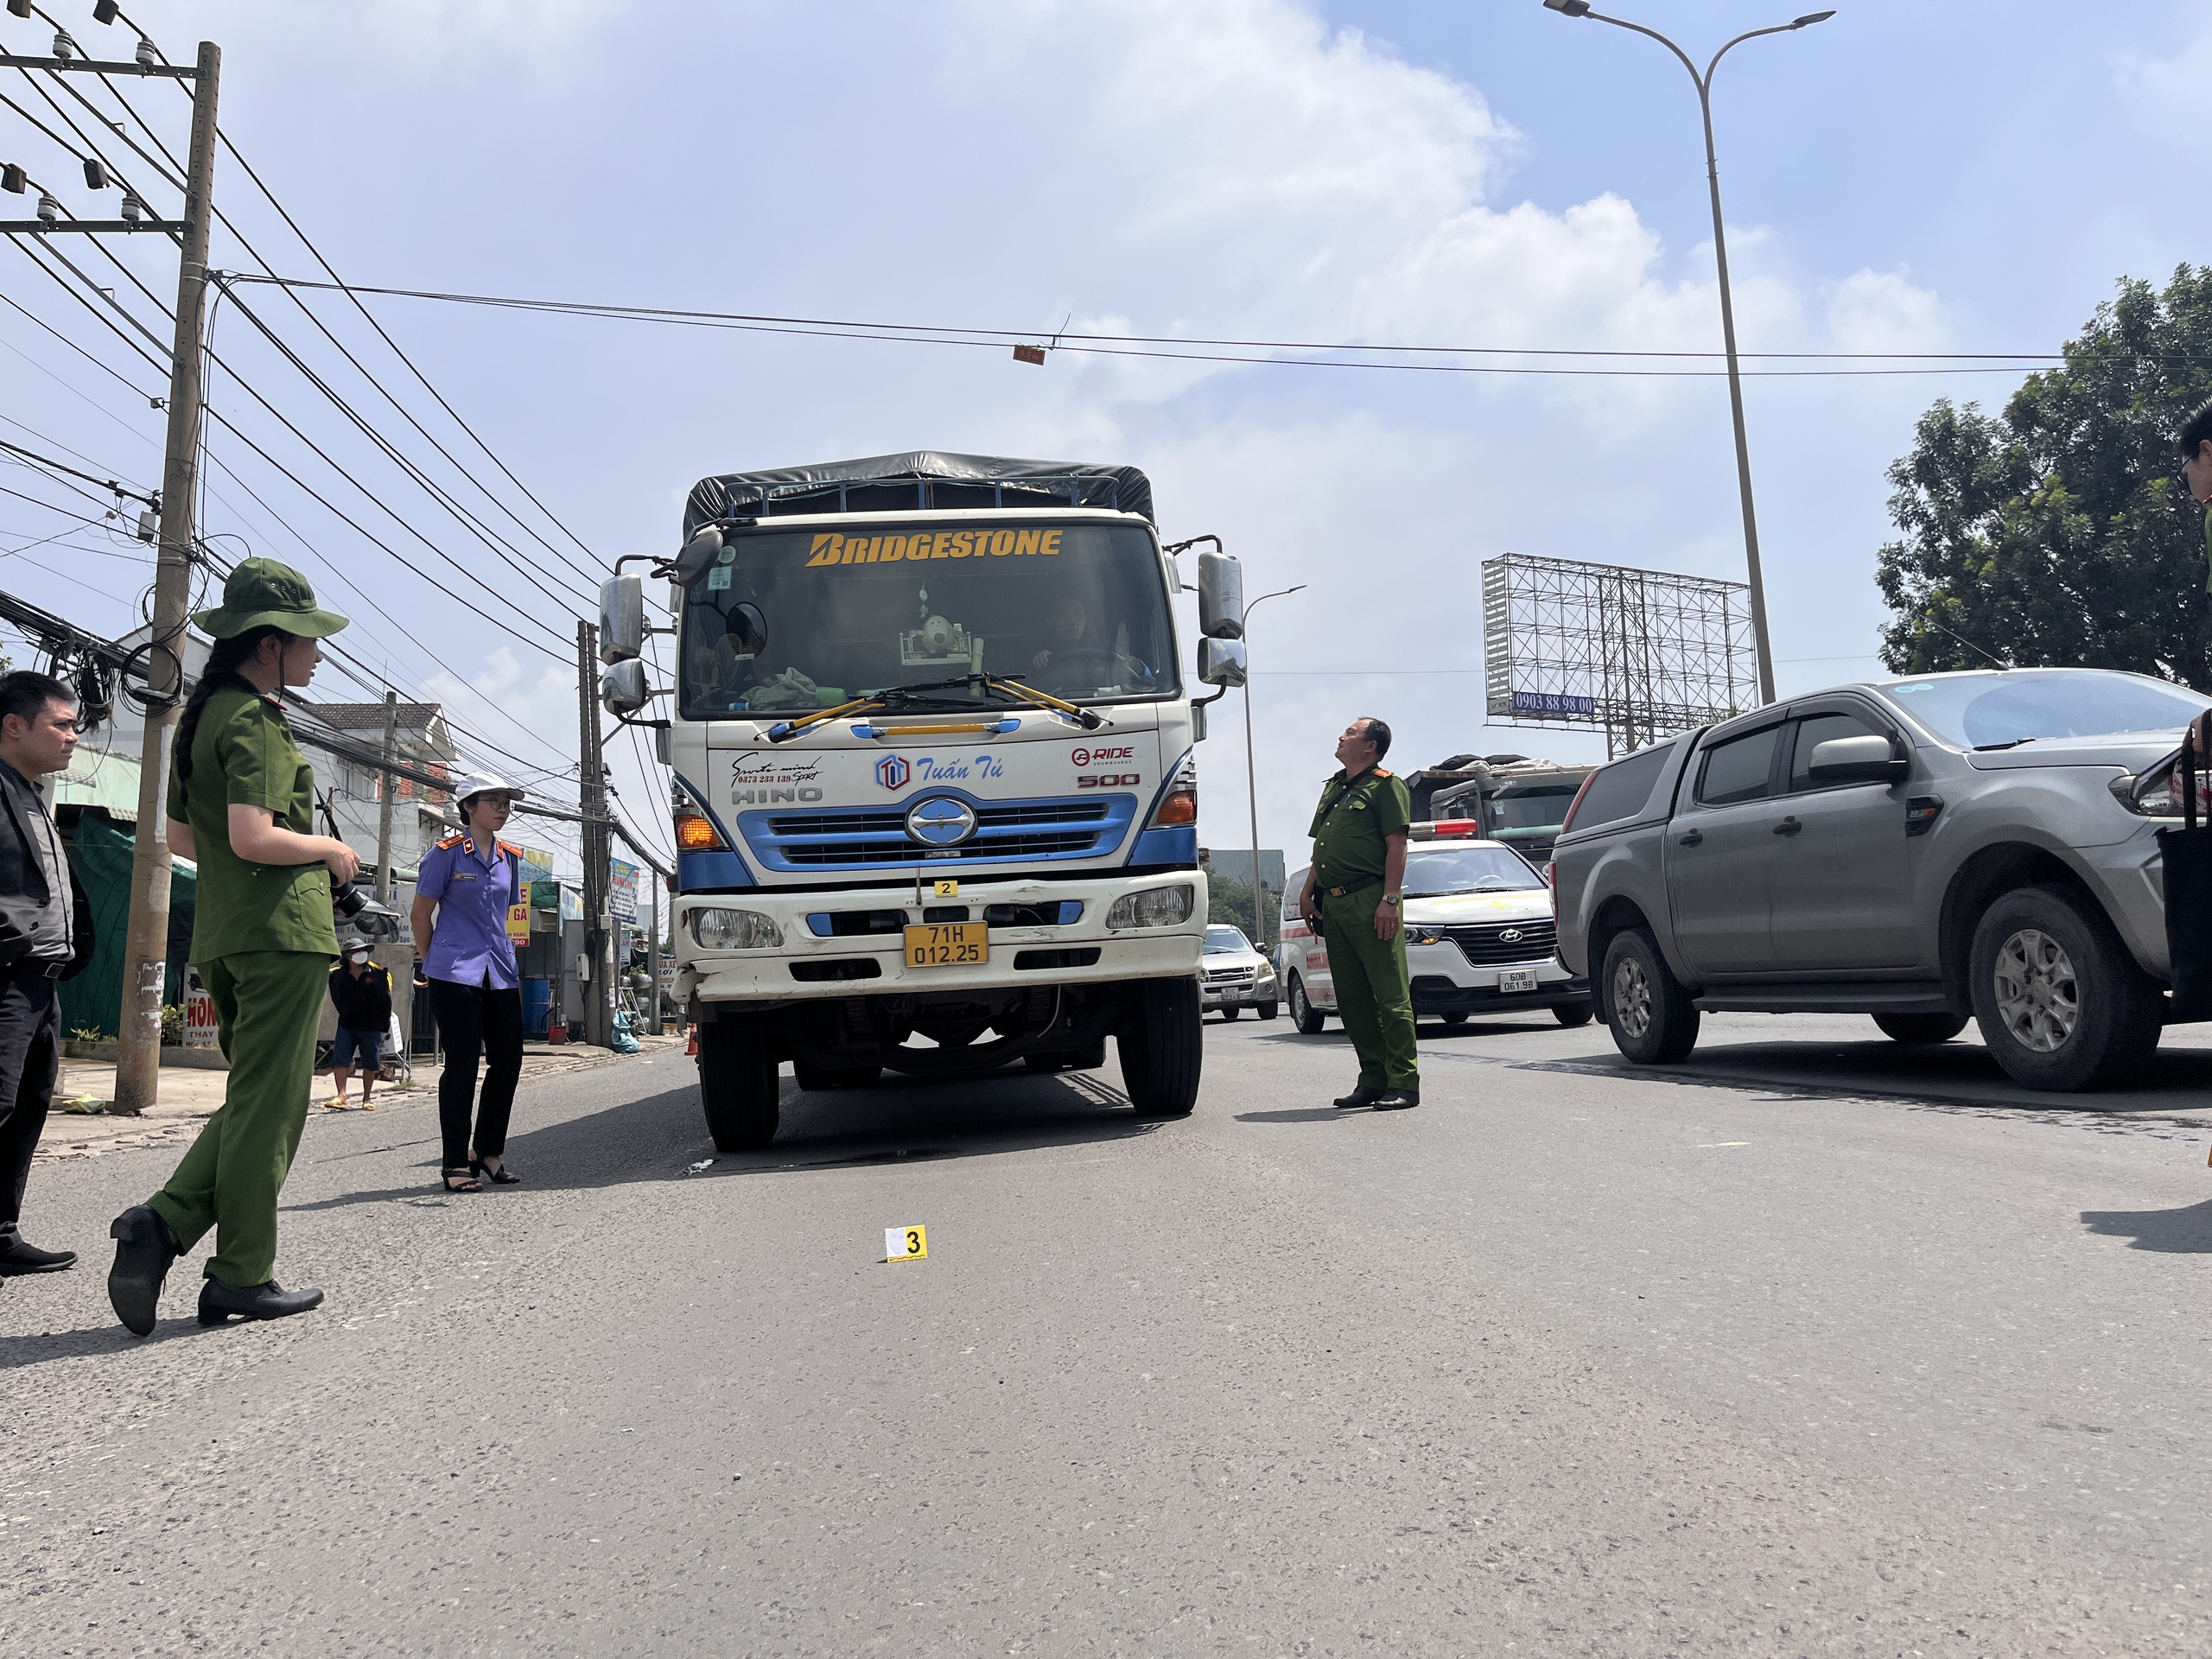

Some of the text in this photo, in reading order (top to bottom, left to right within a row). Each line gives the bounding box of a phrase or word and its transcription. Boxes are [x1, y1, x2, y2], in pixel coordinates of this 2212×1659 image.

[804, 530, 1064, 568] BRIDGESTONE
[1516, 693, 1543, 709] 0903
[1546, 695, 1560, 710] 88
[1562, 696, 1576, 711] 98
[1579, 697, 1592, 713] 00
[1091, 747, 1135, 760] RIDE
[916, 755, 1004, 781] Tuấn Tú
[738, 775, 758, 784] 0373
[759, 775, 775, 784] 233
[1077, 773, 1141, 788] 500
[731, 786, 823, 804] HINO
[942, 882, 951, 894] 2
[514, 908, 527, 921] GA
[928, 925, 963, 944] 71H
[914, 944, 979, 964] 012.25
[907, 1231, 920, 1253] 3
